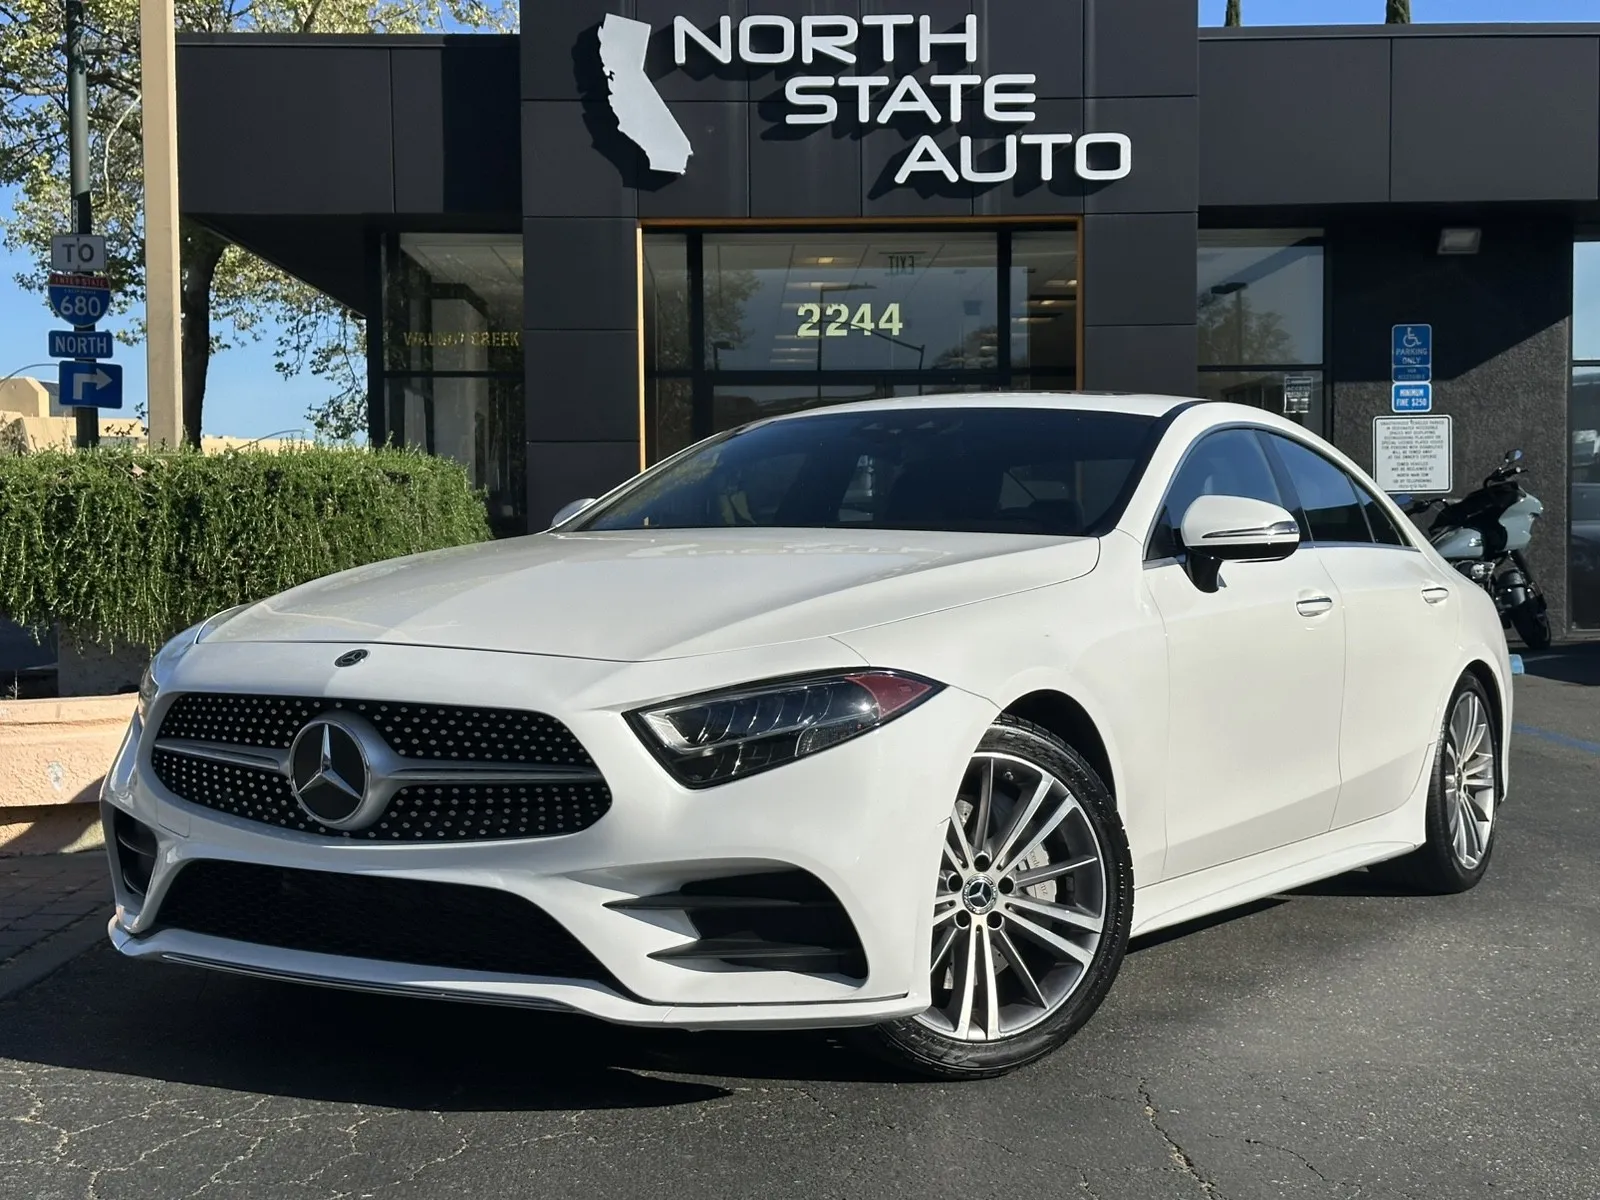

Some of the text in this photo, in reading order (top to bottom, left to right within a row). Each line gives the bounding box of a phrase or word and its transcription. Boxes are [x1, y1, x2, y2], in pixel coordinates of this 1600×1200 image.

[673, 14, 978, 65] NORTH
[784, 73, 1036, 125] STATE
[894, 133, 1132, 184] AUTO
[62, 243, 95, 263] TO
[60, 296, 101, 317] 680
[797, 303, 903, 337] 2244
[55, 336, 107, 354] NORTH
[471, 331, 519, 346] CREEK
[1395, 348, 1428, 356] PARKING
[1402, 357, 1421, 365] ONLY
